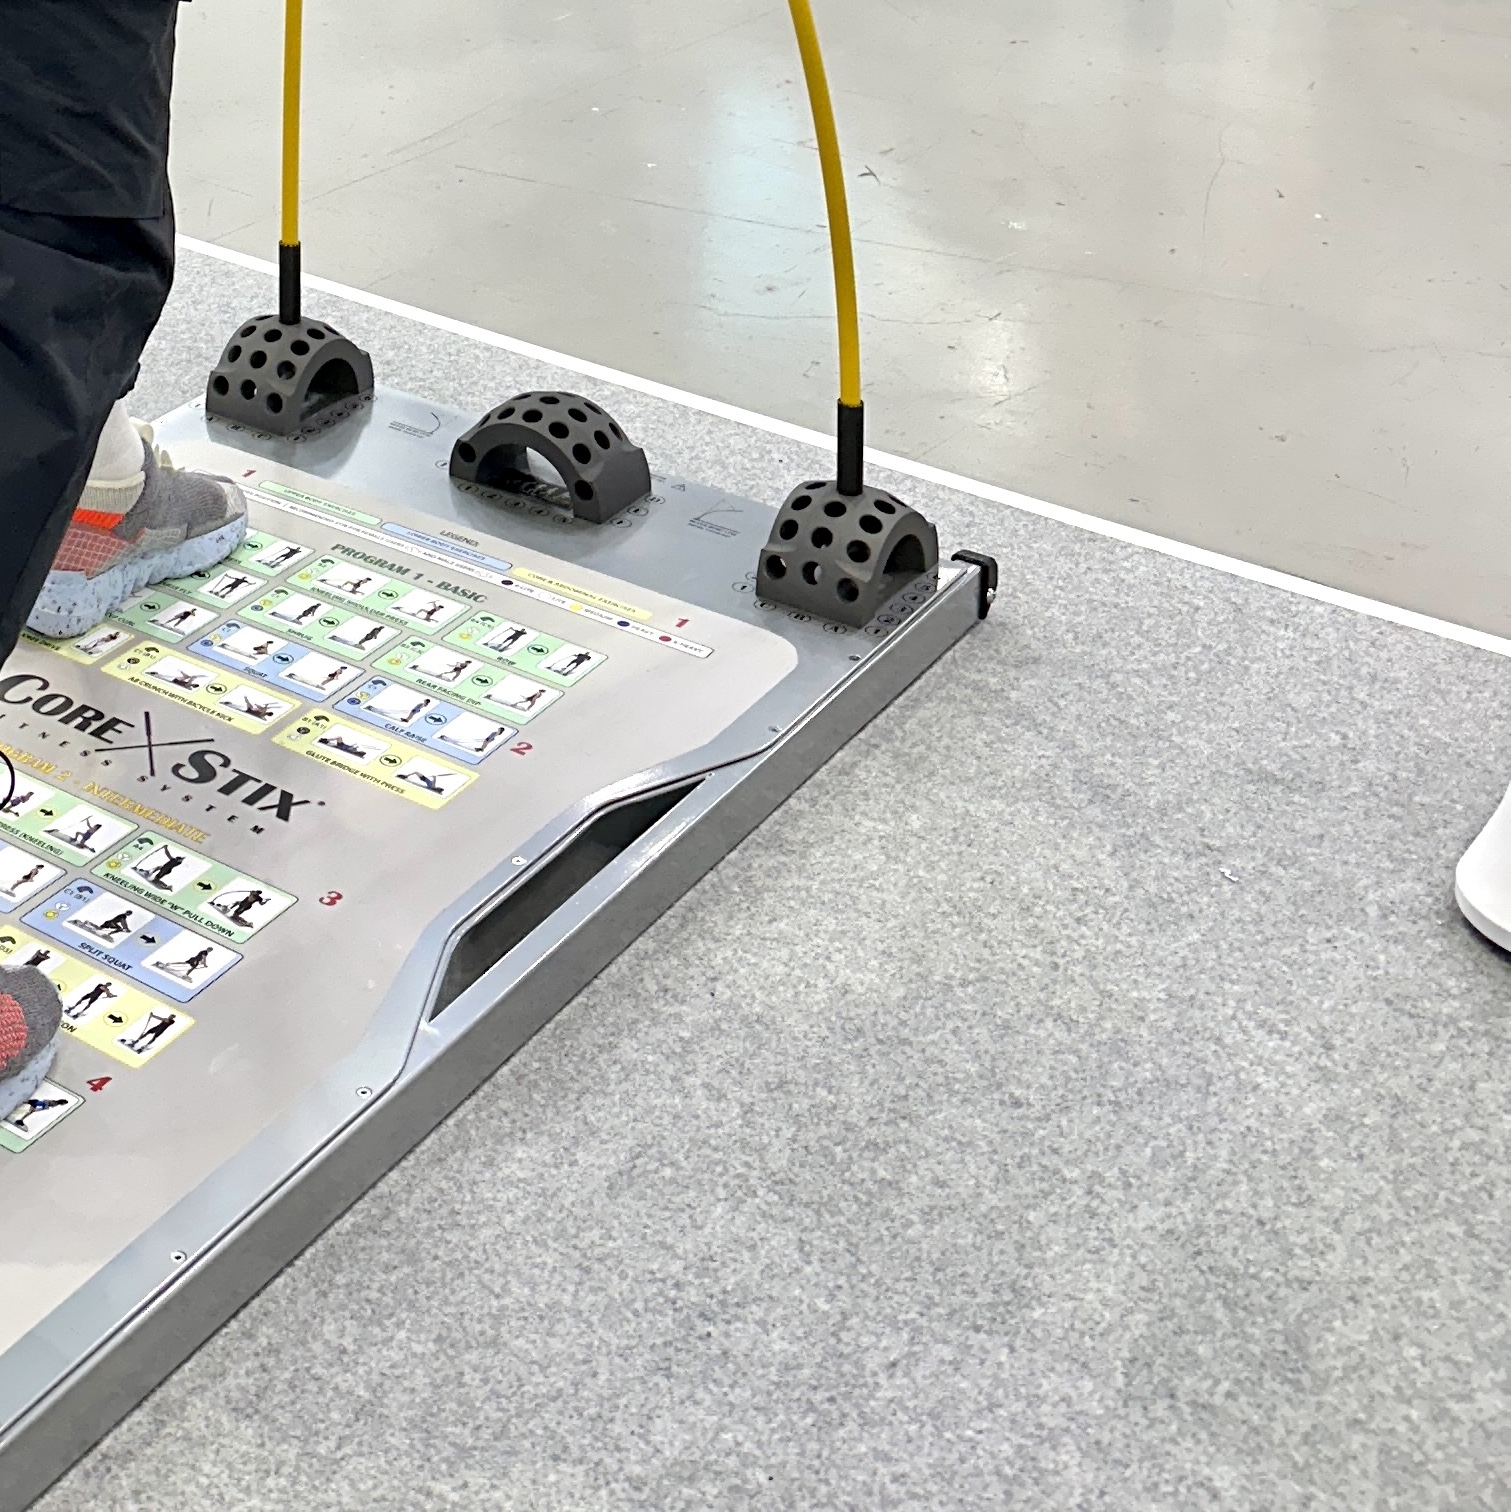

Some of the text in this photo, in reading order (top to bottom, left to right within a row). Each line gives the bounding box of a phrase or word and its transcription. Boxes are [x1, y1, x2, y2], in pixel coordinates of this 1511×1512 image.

[330, 543, 411, 576] PROGRAM
[434, 580, 488, 604] BASIC
[509, 741, 533, 756] 2
[170, 750, 310, 824] STIX
[103, 872, 145, 897] KNEELING
[143, 891, 169, 907] WIDE
[182, 908, 205, 924] PULL
[204, 919, 235, 938] DOWN
[319, 890, 343, 906] 3
[78, 941, 133, 973] SPLIT SQUAT
[87, 1076, 113, 1093] 4
